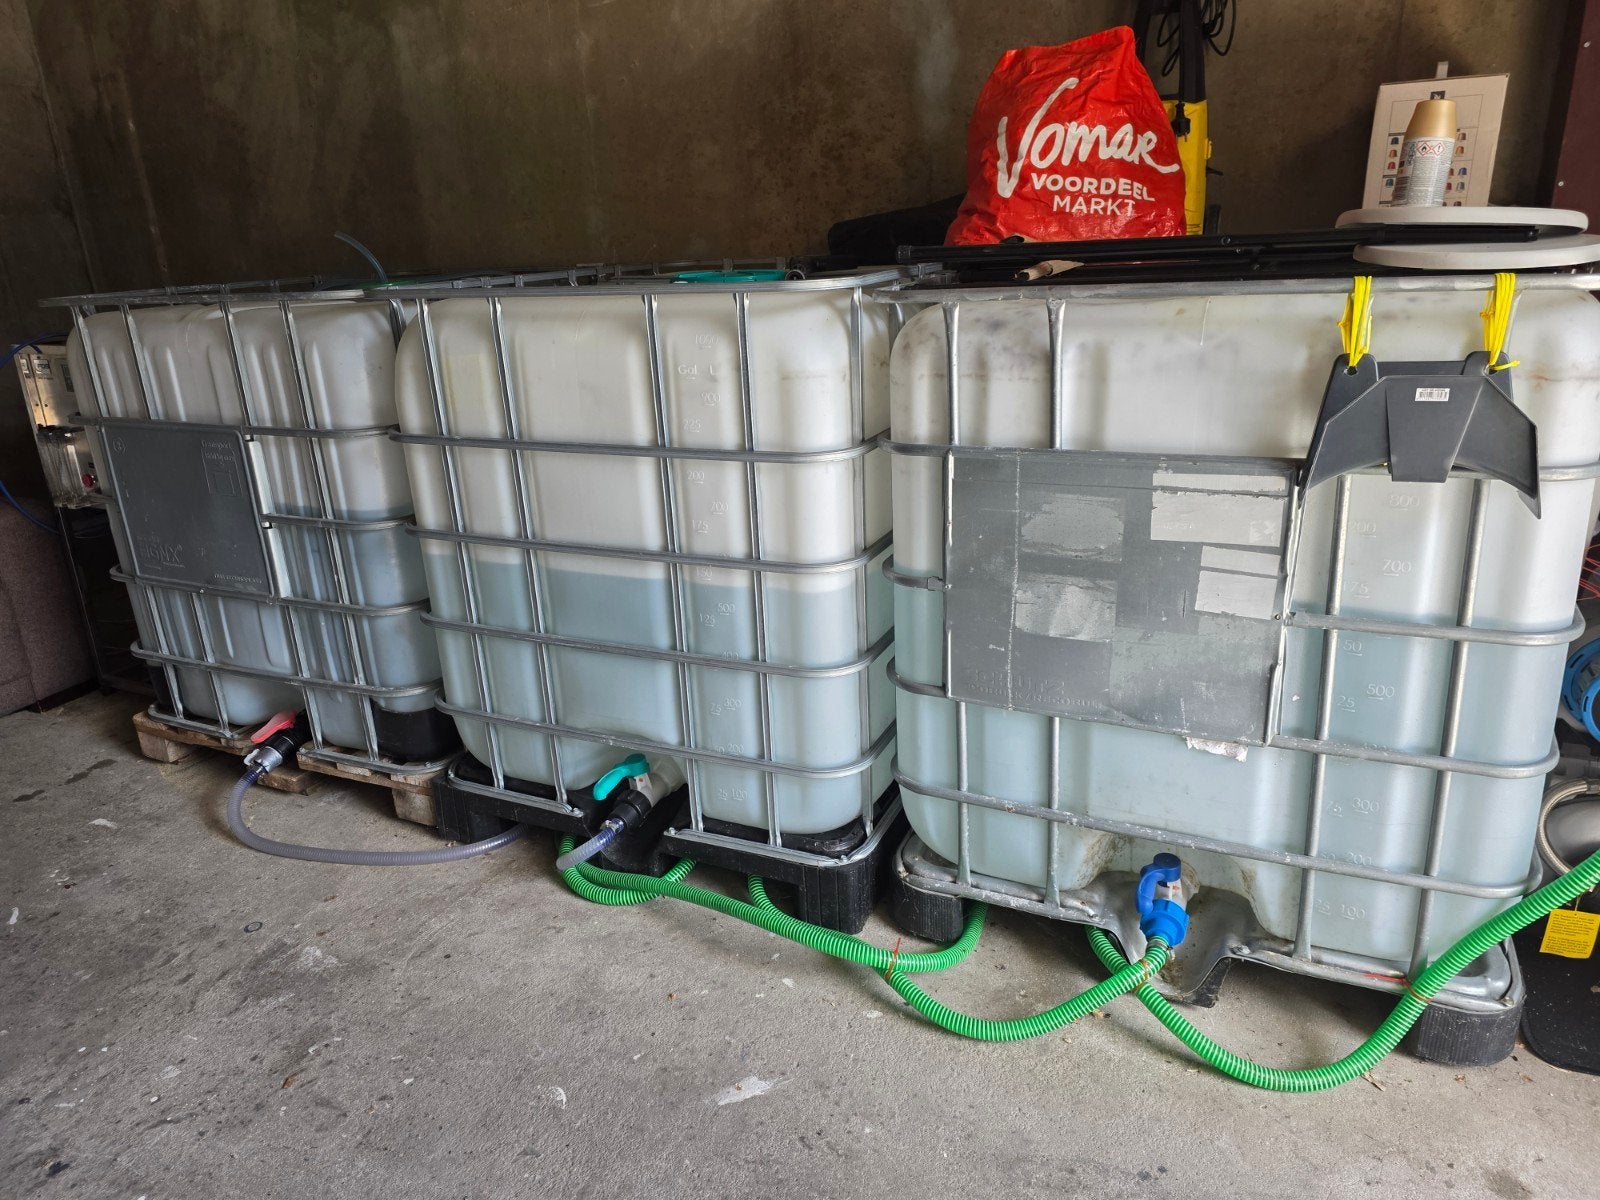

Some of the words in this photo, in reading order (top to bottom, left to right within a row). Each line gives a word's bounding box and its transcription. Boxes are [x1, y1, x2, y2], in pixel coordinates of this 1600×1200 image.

[1031, 172, 1155, 201] VOORDEEL
[1053, 195, 1136, 217] MARKT
[1389, 494, 1420, 508] 800
[1382, 559, 1412, 573] 700
[1366, 683, 1395, 698] 500
[1336, 695, 1355, 708] 25
[1352, 797, 1381, 812] 300
[1341, 904, 1366, 919] 100
